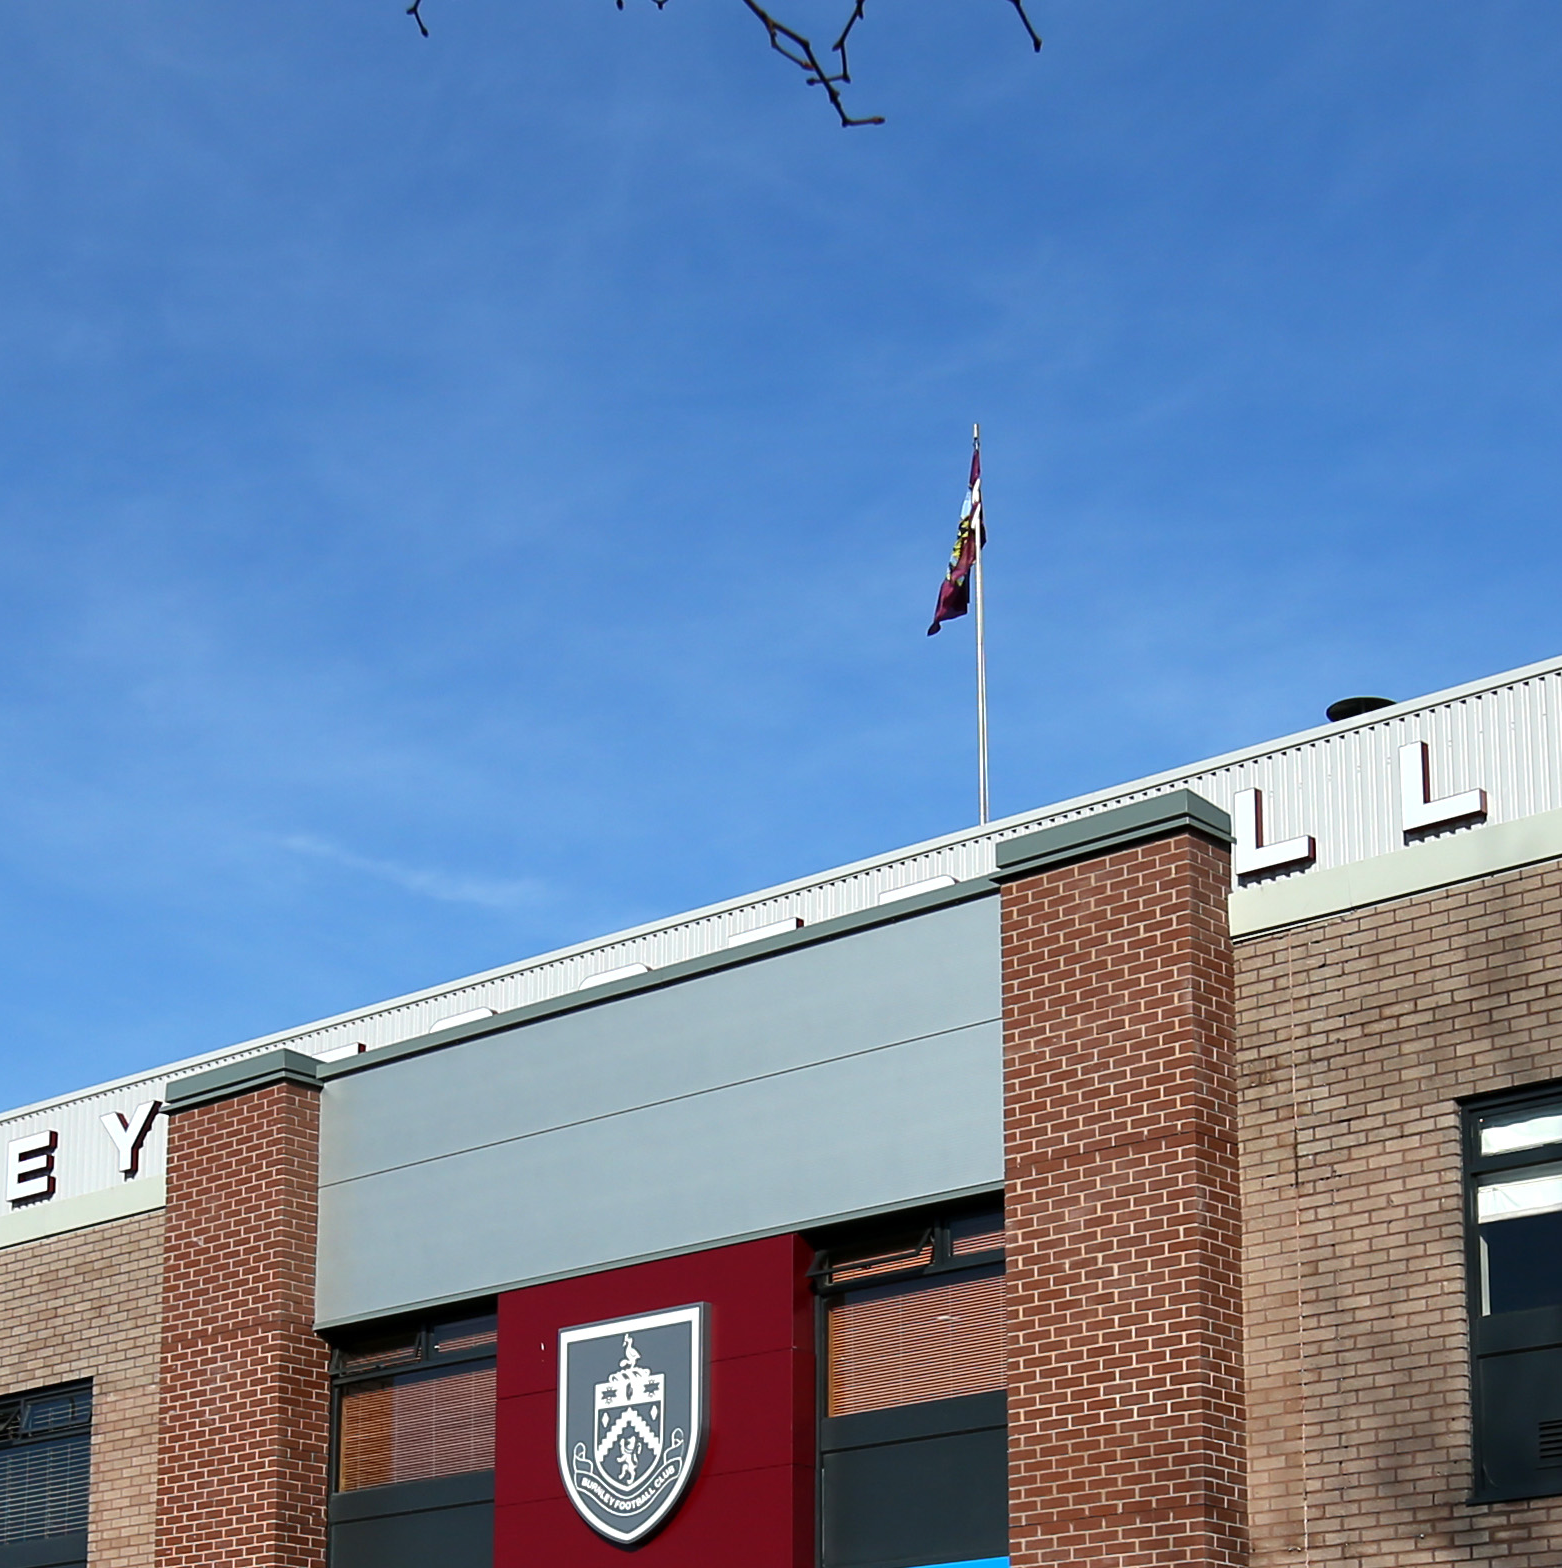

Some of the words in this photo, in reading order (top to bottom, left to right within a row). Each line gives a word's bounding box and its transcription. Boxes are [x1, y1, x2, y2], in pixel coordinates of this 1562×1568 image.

[581, 1477, 614, 1506] BURNLEY
[615, 1488, 655, 1510] FOOTBALL
[654, 1465, 675, 1488] CLUB
